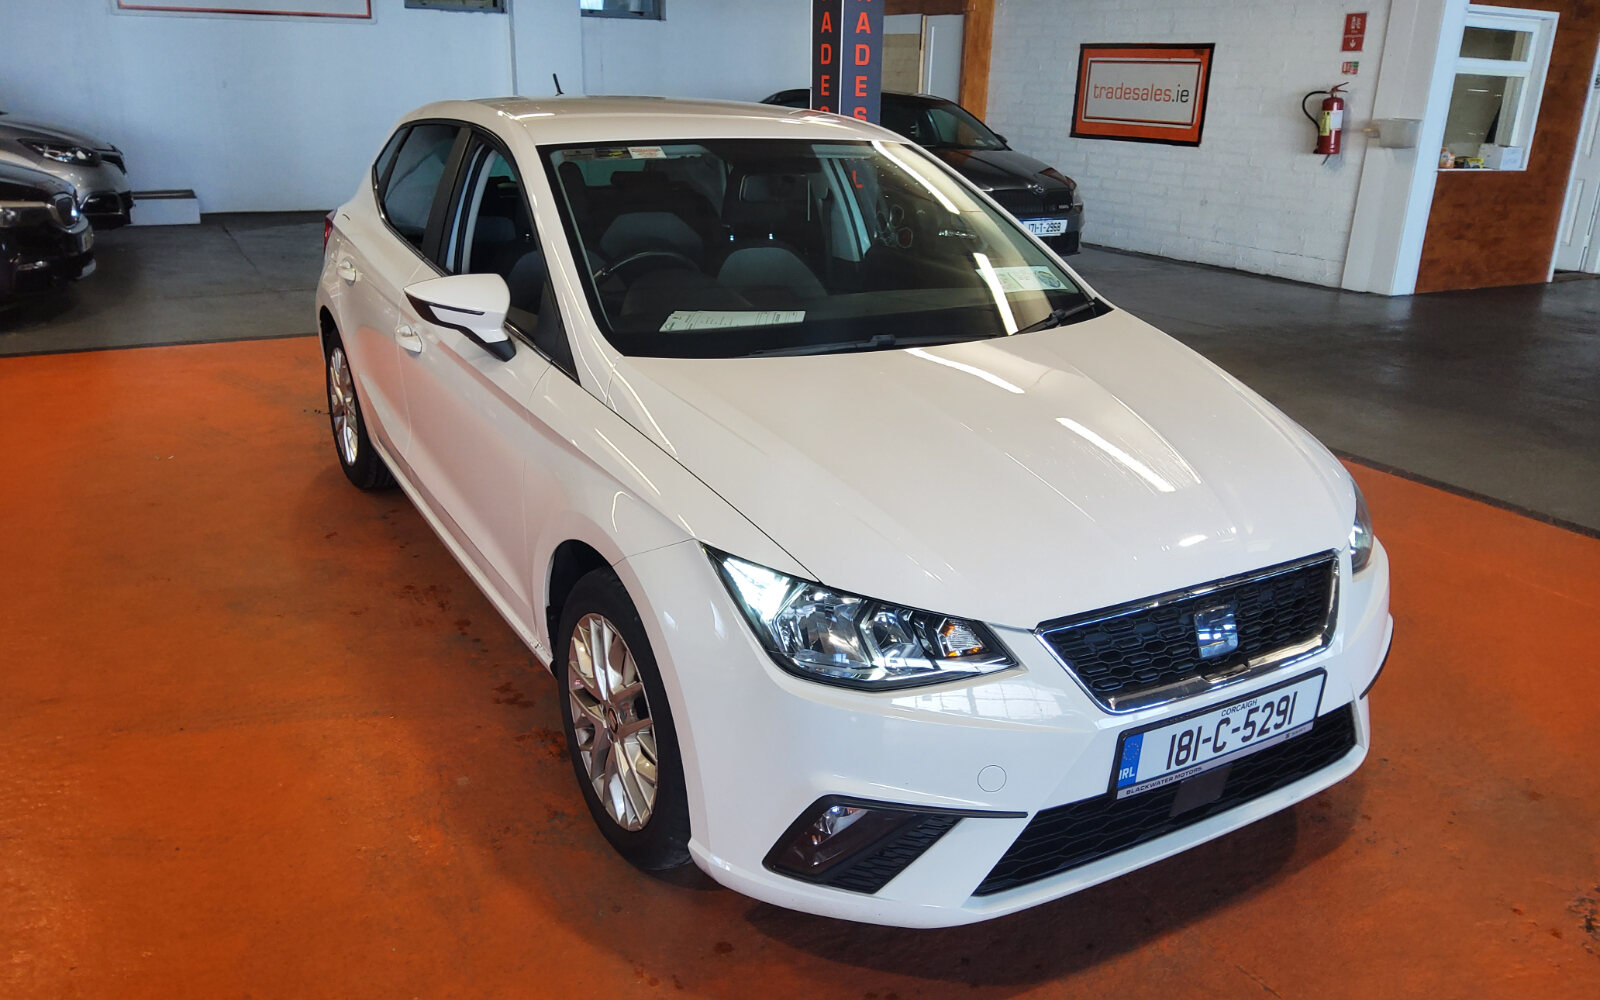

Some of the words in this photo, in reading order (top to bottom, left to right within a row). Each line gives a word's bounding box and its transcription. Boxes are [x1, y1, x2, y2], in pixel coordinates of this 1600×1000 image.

[820, 0, 832, 112] ADE
[853, 0, 871, 121] ADES
[1093, 82, 1190, 103] tradesales.ie
[1221, 698, 1258, 717] CORCAIGH
[1166, 691, 1298, 770] 181-C-5291
[1118, 765, 1136, 781] IRL
[1126, 776, 1174, 795] BLACKWATER
[1174, 766, 1203, 780] MOTORS
